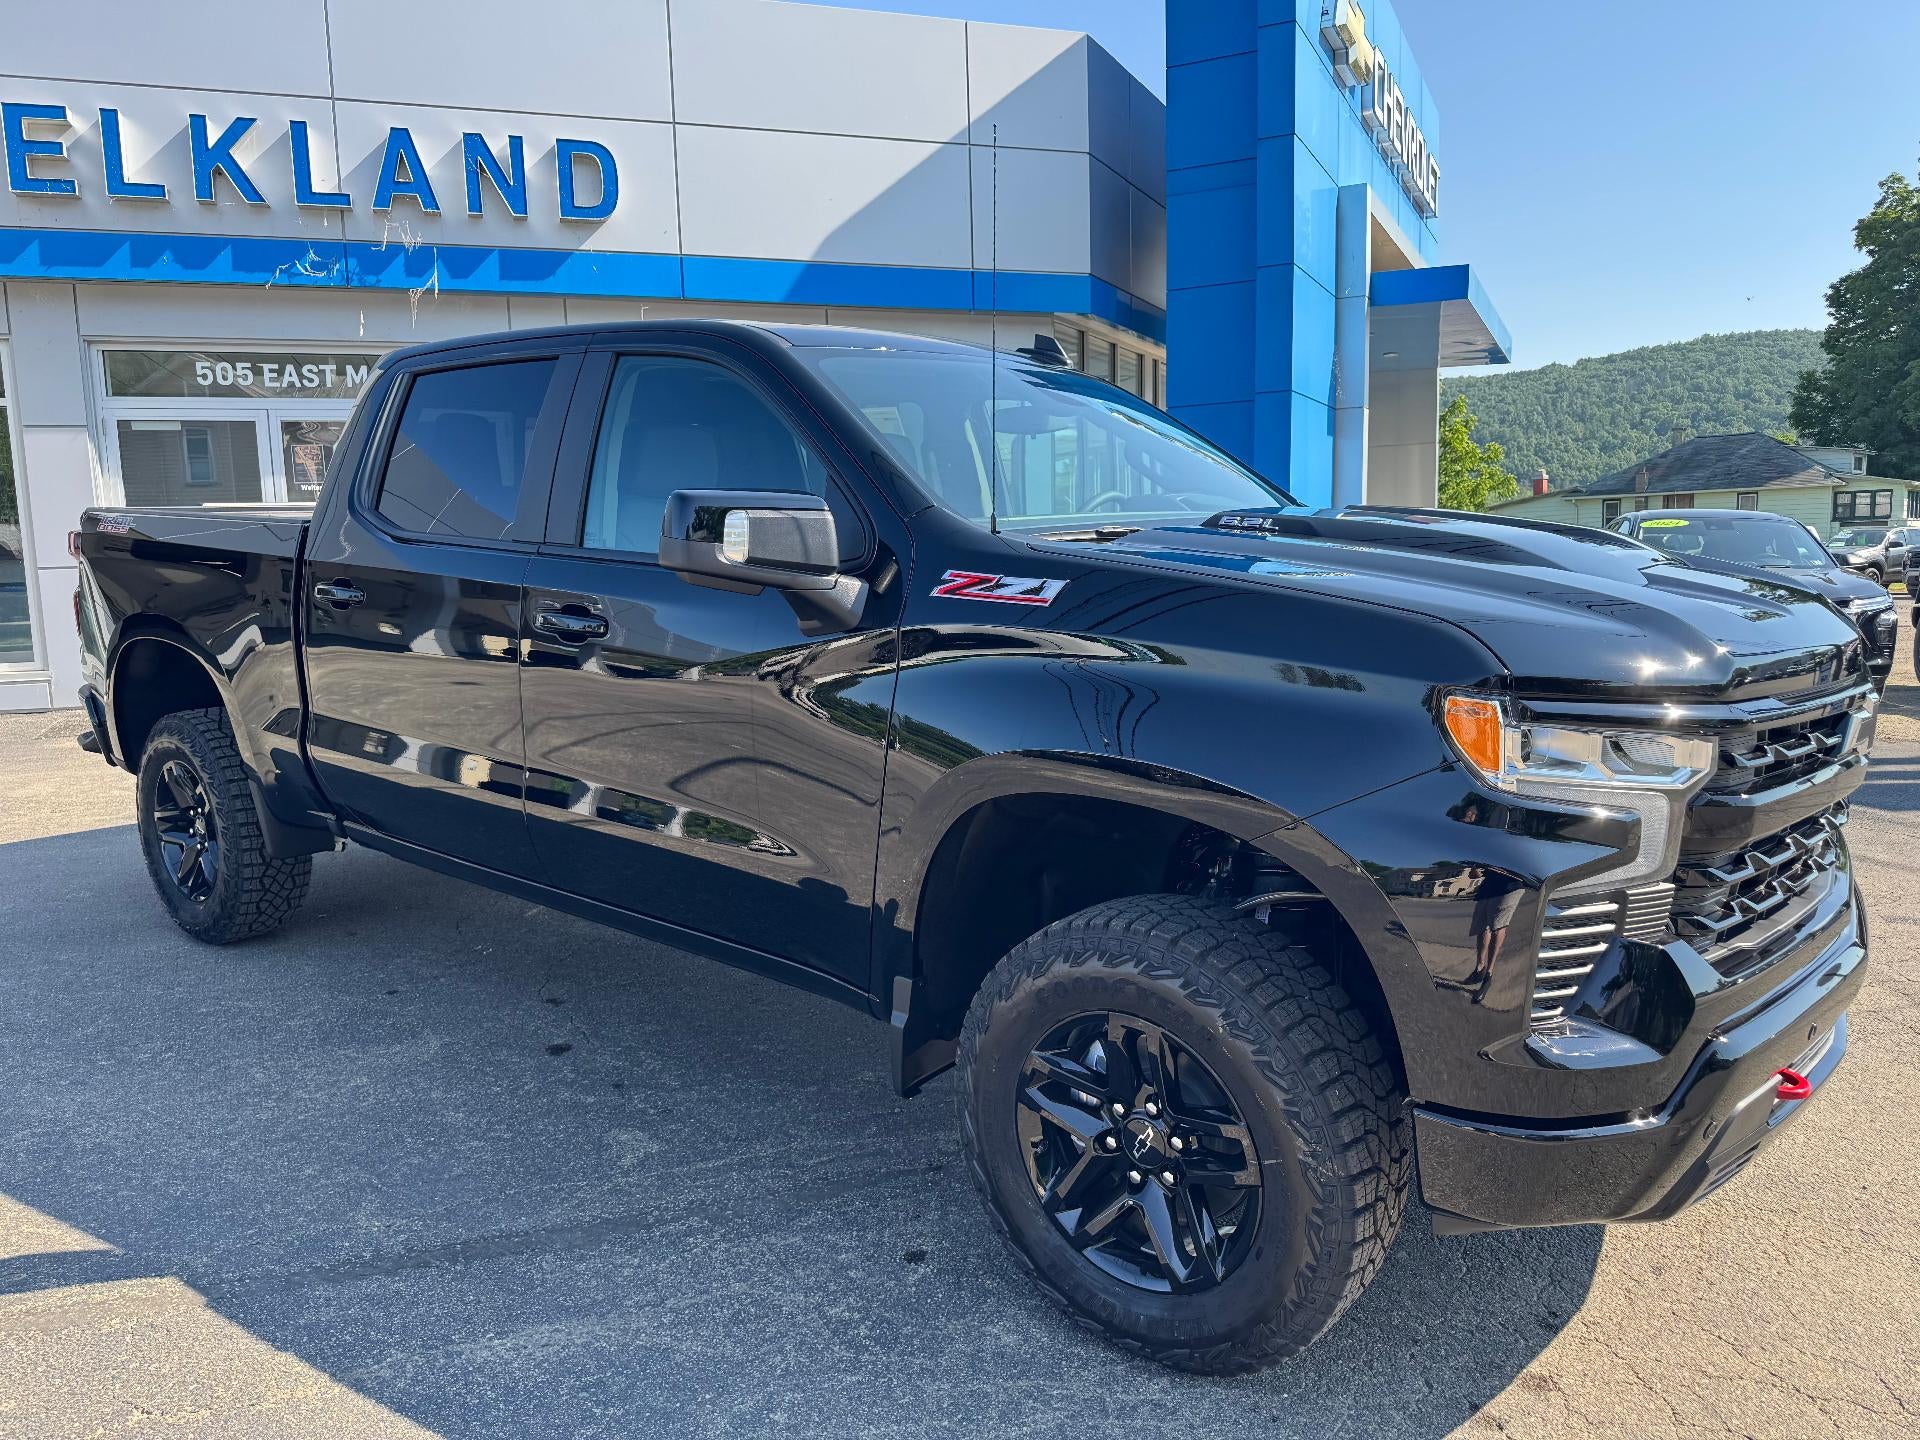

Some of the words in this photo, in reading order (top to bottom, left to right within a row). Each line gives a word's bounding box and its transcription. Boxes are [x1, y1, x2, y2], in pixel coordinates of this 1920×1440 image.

[1367, 45, 1440, 217] CHEVROLET
[0, 102, 620, 224] ELKLAND
[195, 361, 254, 386] 505
[262, 362, 337, 388] EAST
[97, 523, 129, 533] BOSS
[98, 514, 136, 526] TRAIL
[929, 569, 1071, 607] Z71
